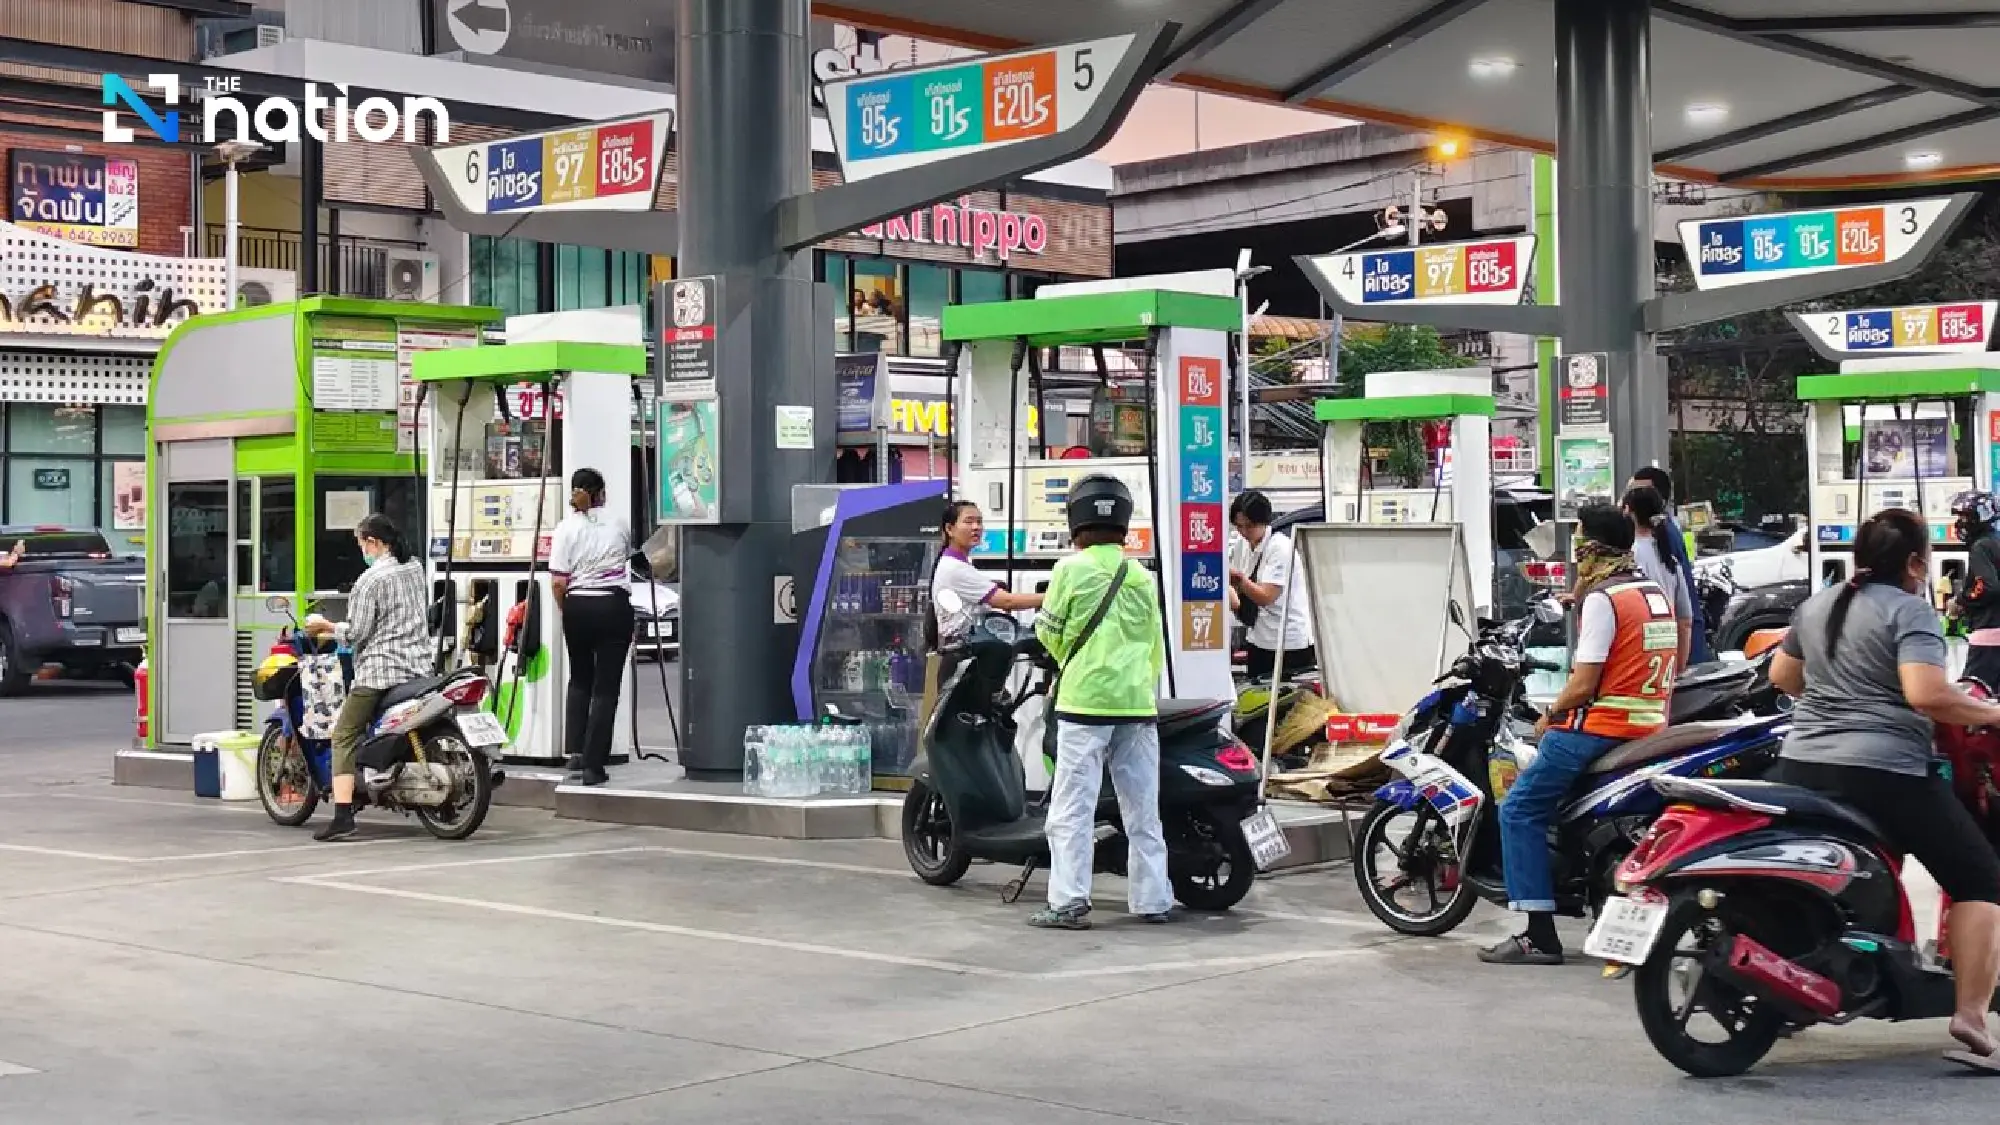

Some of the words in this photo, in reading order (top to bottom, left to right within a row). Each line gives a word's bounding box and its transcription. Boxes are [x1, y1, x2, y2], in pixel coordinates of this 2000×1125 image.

[1074, 48, 1094, 91] 5
[466, 150, 479, 183] 6
[555, 152, 585, 186] 97
[126, 184, 135, 196] 2
[18, 188, 103, 224] จัดฟัน
[1901, 206, 1917, 235] 3
[1342, 257, 1355, 280] 4
[1427, 262, 1453, 287] 97
[1828, 317, 1840, 335] 2
[1904, 320, 1928, 340] 97
[1193, 617, 1212, 640] 97
[1641, 655, 1675, 694] 24
